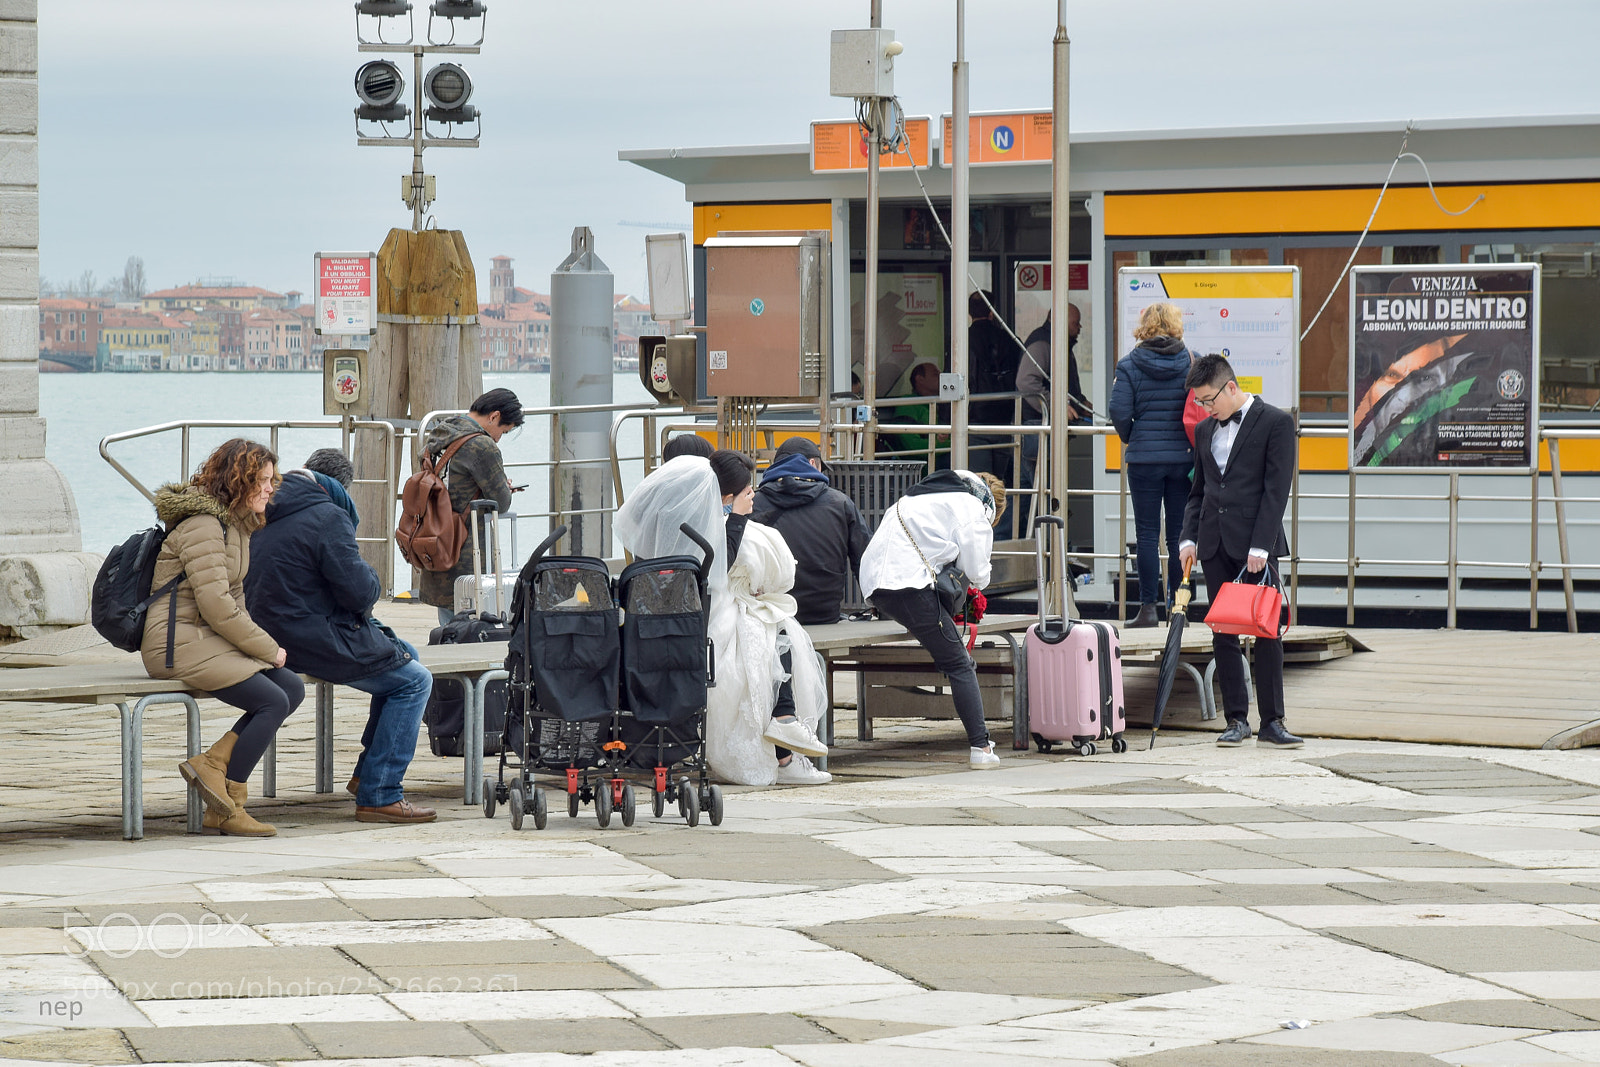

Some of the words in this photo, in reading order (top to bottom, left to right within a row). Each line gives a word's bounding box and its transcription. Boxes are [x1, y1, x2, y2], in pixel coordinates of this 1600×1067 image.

[996, 131, 1009, 147] N
[1411, 276, 1478, 291] VENEZIA
[1221, 309, 1228, 317] 2
[1362, 298, 1429, 321] LEONI
[1435, 297, 1527, 320] DENTRO
[1362, 321, 1406, 332] ABBONATI,
[1407, 321, 1449, 331] VOGLIAMO
[1450, 320, 1488, 330] SENTIRTI
[1489, 320, 1527, 330] RUGGIRE
